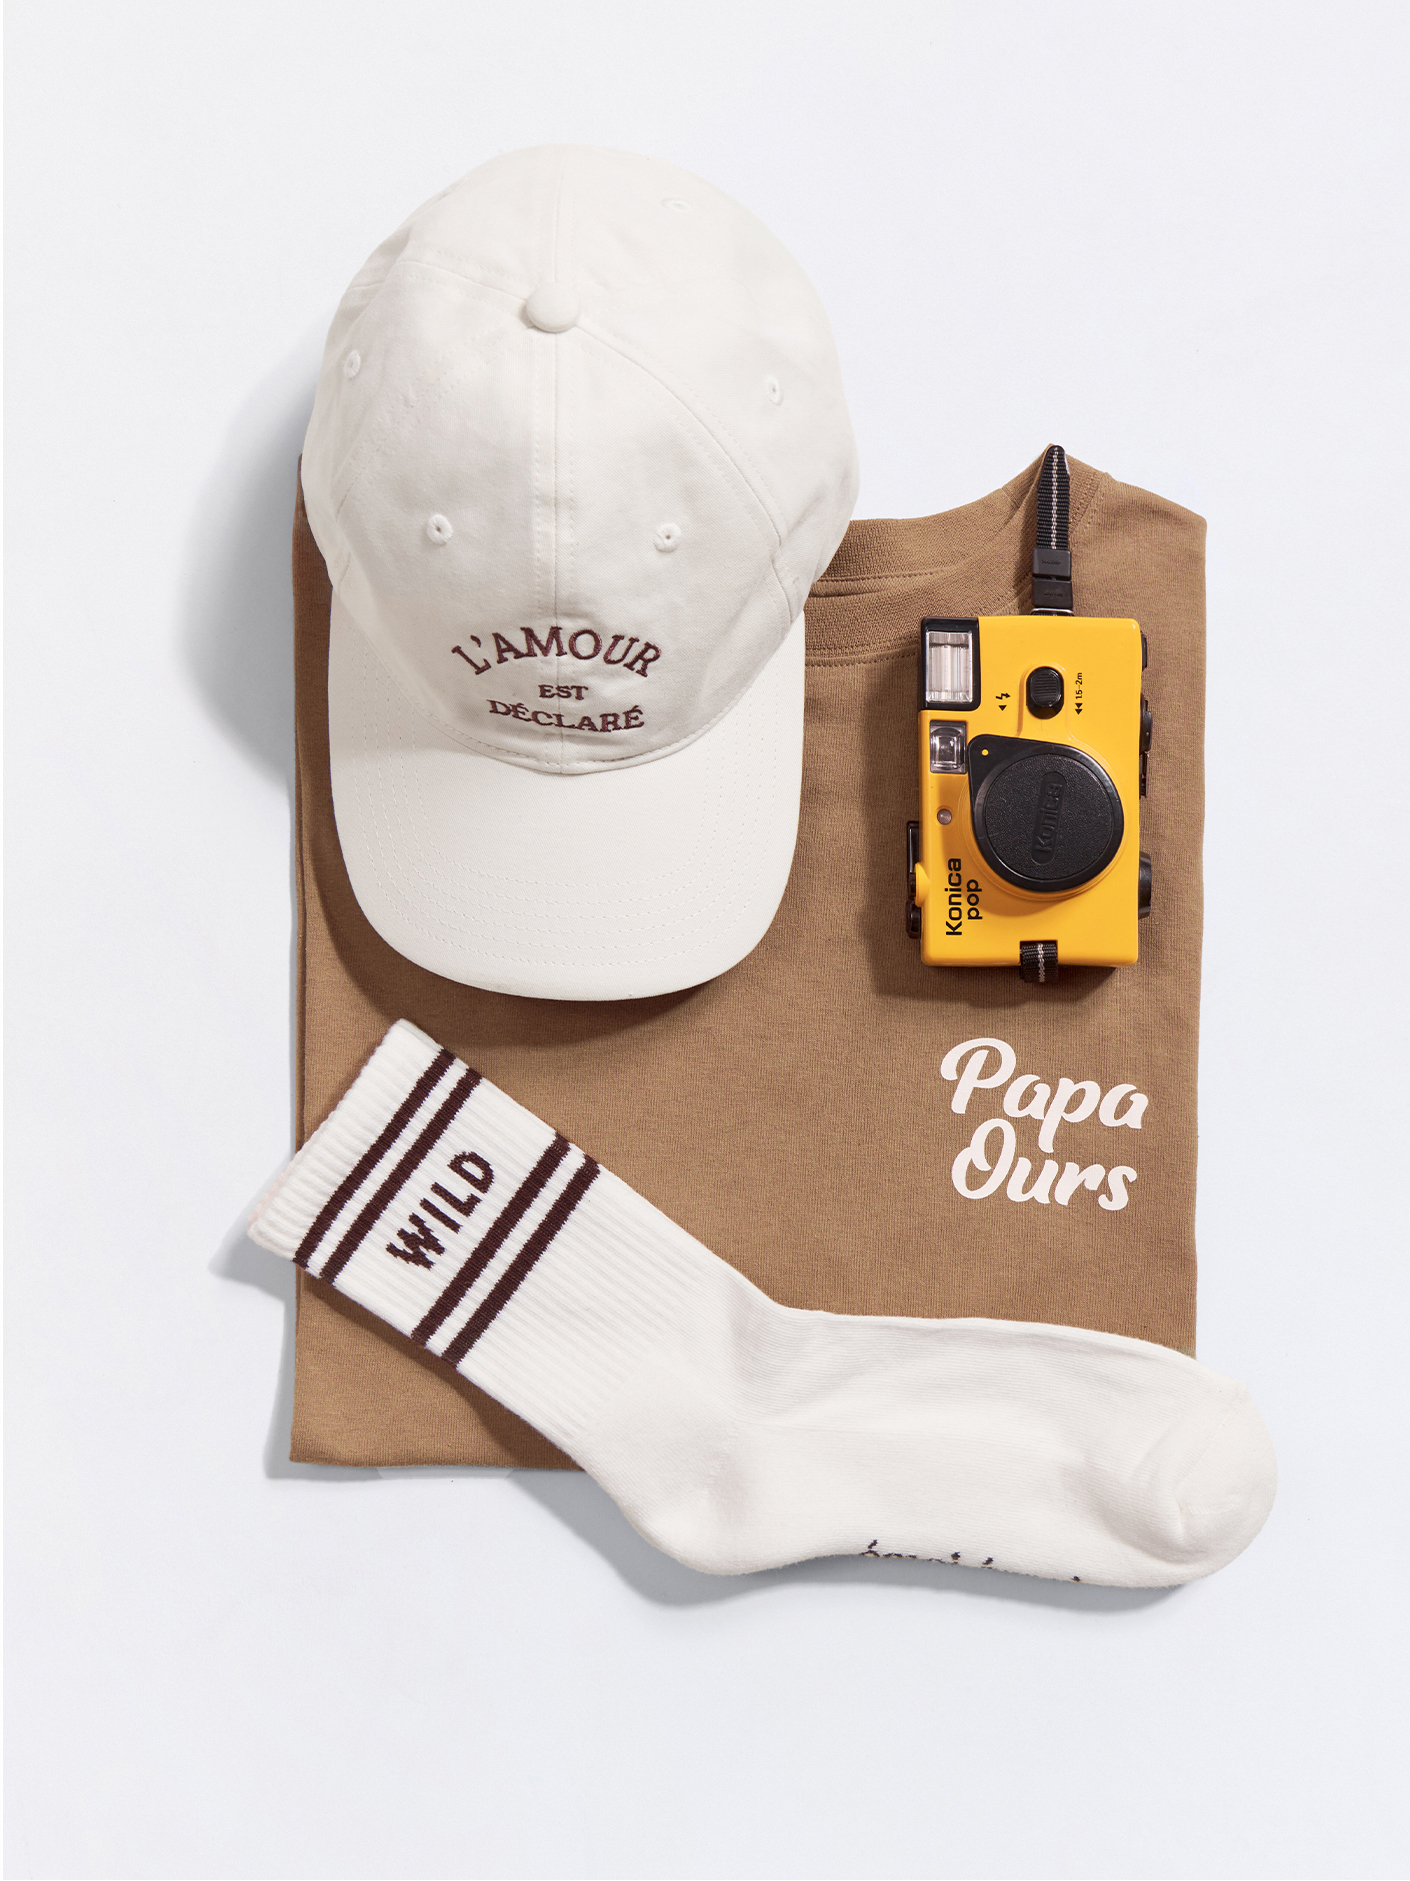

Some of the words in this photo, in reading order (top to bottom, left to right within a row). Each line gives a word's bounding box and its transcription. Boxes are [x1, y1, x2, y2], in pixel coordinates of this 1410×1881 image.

[451, 626, 661, 677] L'AMOUR
[486, 699, 645, 733] DÉCLARÉ
[538, 684, 589, 701] EST
[1034, 782, 1063, 853] Konica
[944, 858, 963, 936] Konica
[966, 879, 983, 920] pop
[940, 1037, 1149, 1153] Papa
[951, 1118, 1138, 1211] Ours
[385, 1151, 495, 1271] WILD
